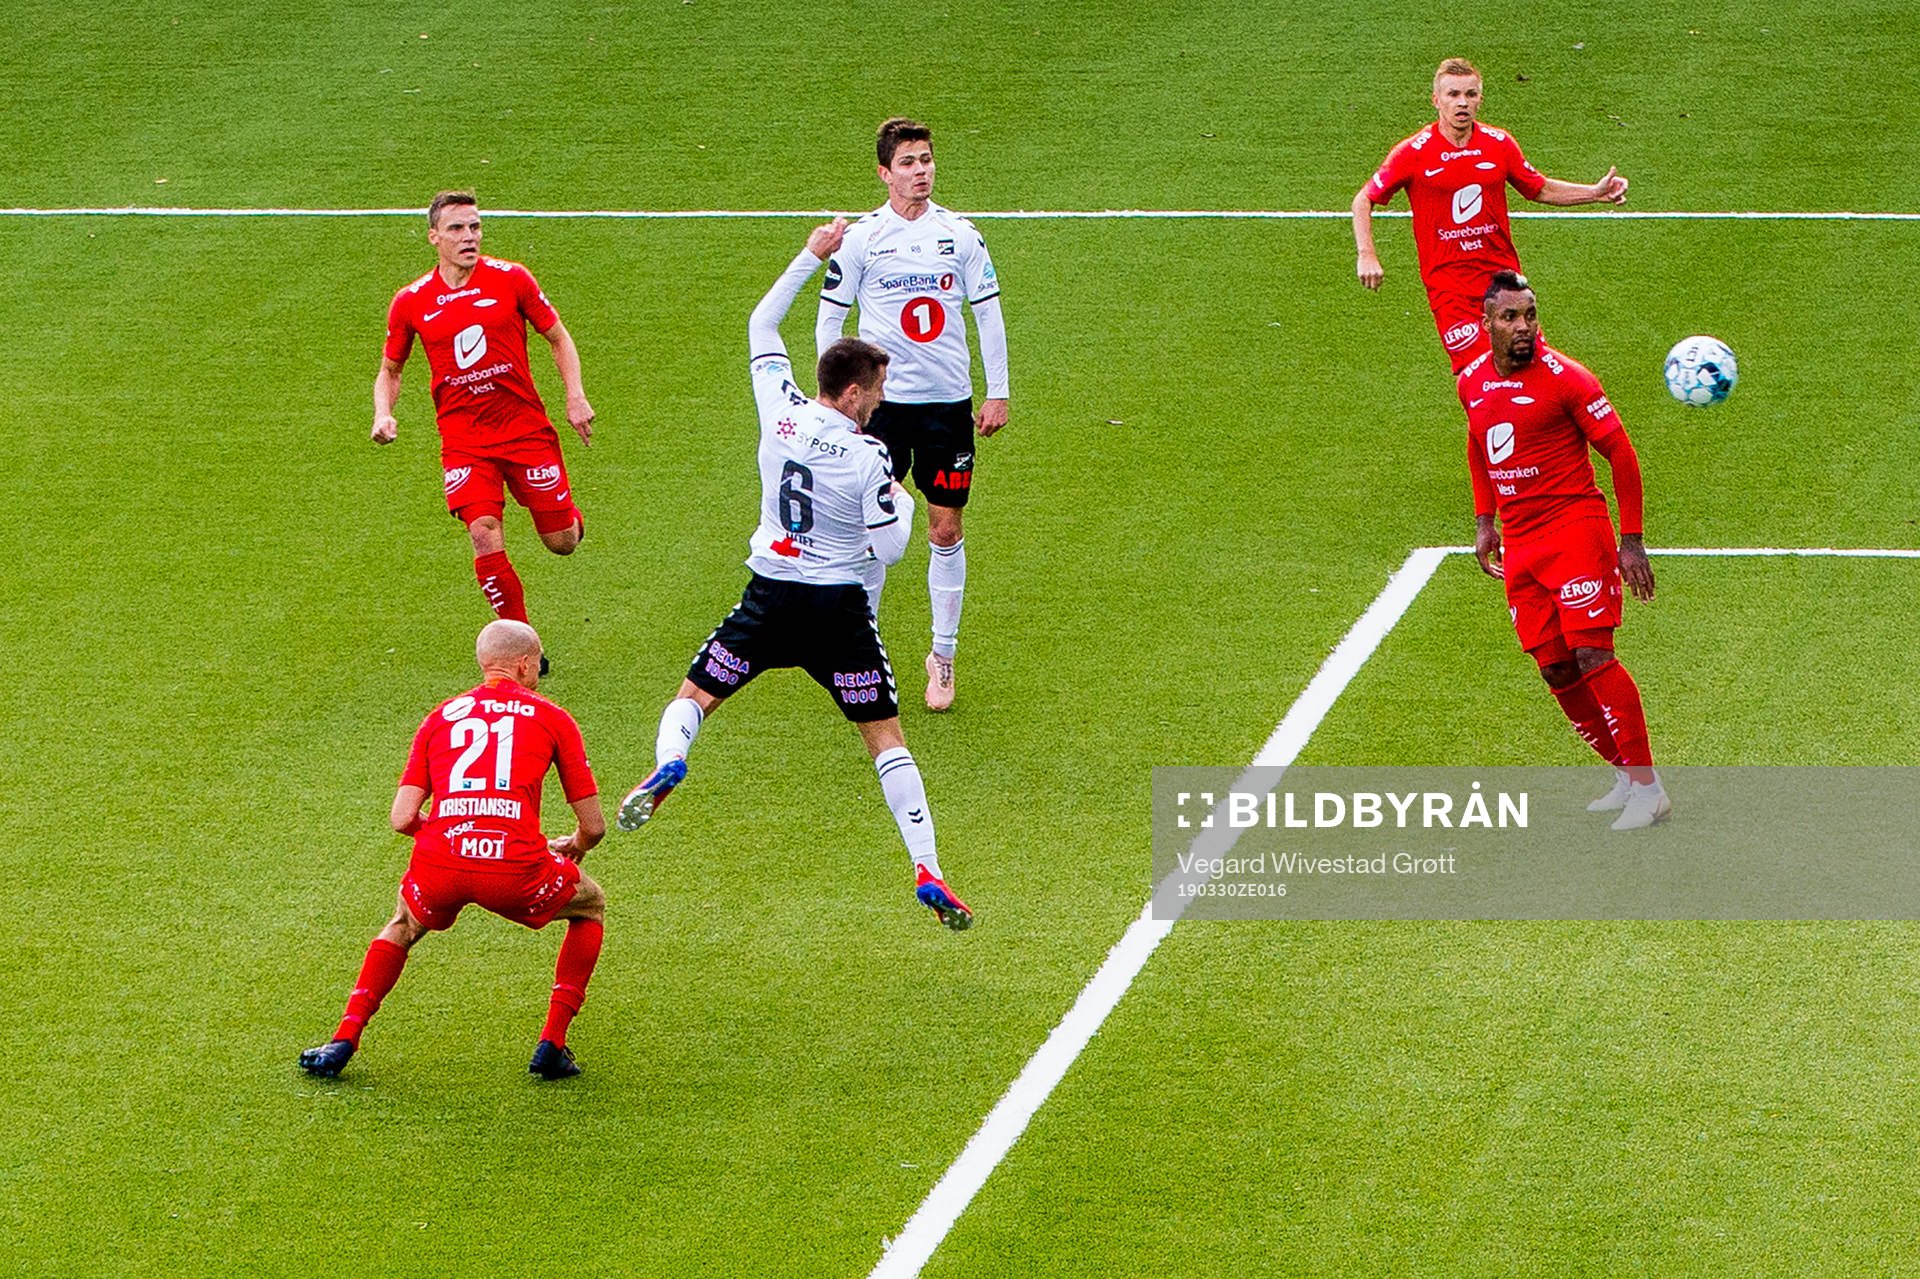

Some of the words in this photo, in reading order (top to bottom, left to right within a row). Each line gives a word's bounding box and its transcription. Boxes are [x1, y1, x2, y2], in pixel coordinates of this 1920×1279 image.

[1460, 239, 1483, 251] Vest
[912, 303, 931, 335] 1
[1541, 353, 1564, 375] BOB
[469, 382, 495, 395] Vest
[780, 459, 814, 533] 6
[1496, 483, 1517, 496] Vest
[709, 641, 750, 675] REMA
[705, 658, 739, 685] 1000
[833, 670, 882, 687] REMA
[841, 687, 878, 704] 1000
[480, 699, 535, 716] Telia
[449, 715, 515, 793] 21
[438, 797, 522, 820] KRISTIANSEN
[461, 837, 504, 858] MOT
